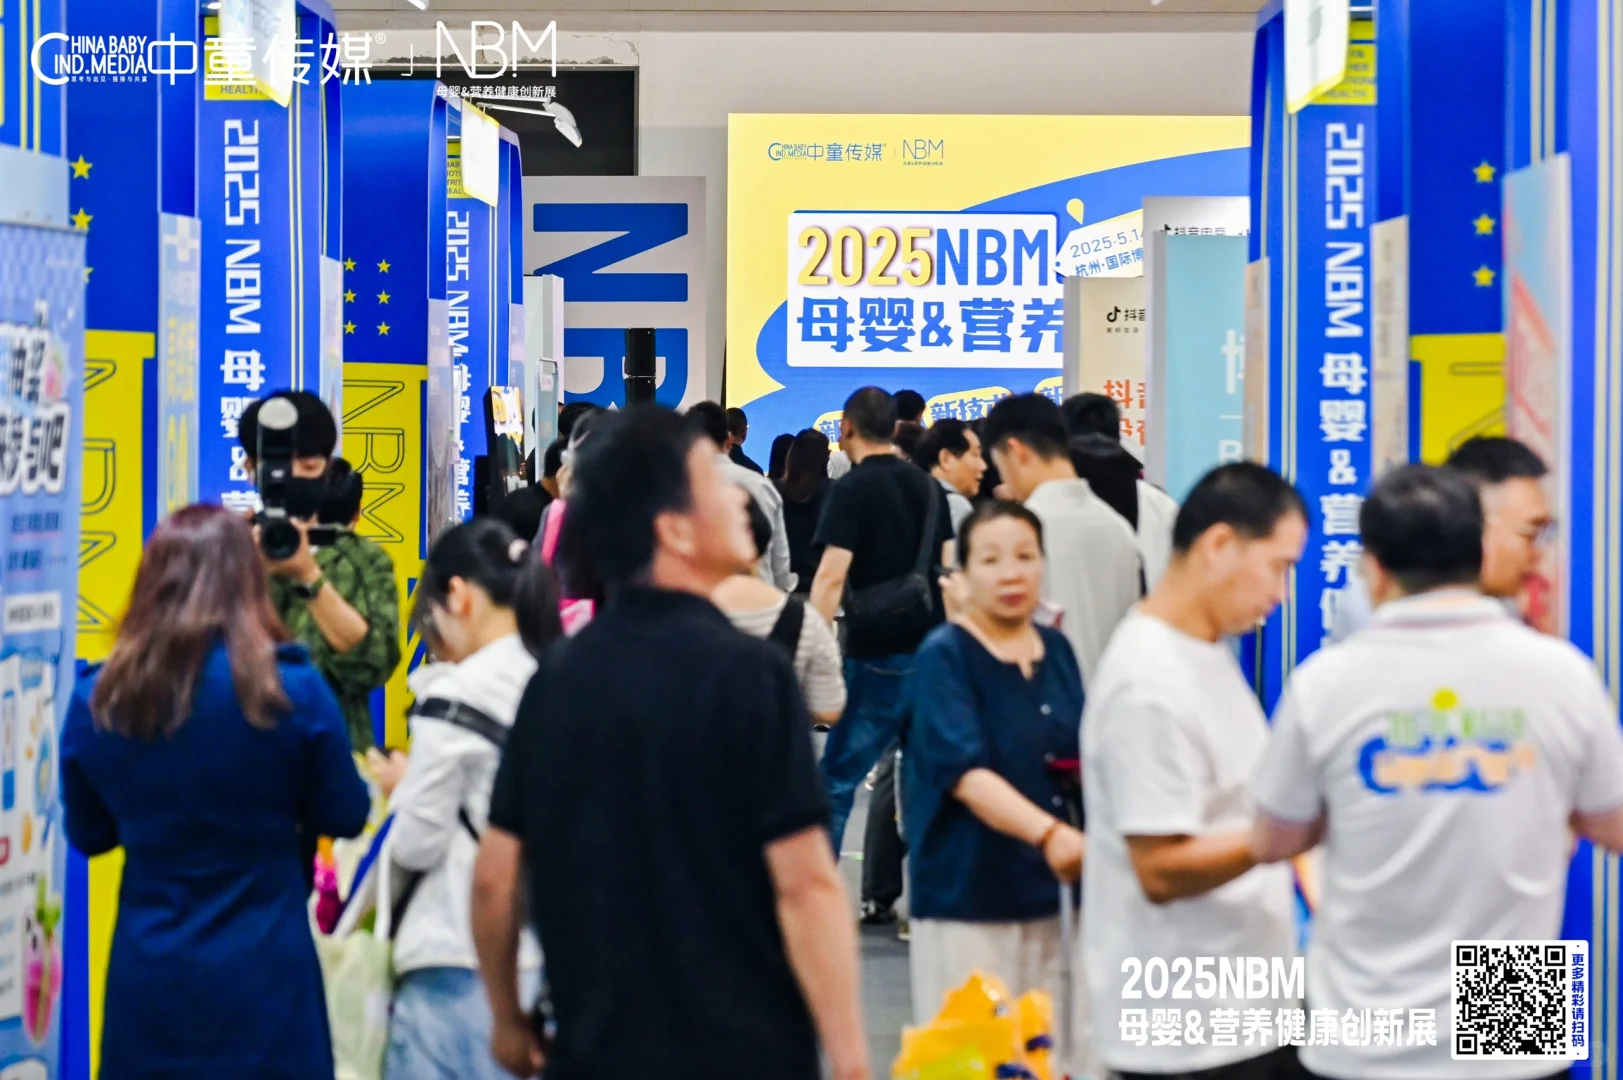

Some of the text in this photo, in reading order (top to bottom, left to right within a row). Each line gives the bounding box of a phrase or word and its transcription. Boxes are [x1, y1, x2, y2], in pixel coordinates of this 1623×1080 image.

[224, 119, 260, 226] 2025
[806, 143, 883, 161] 中童传媒
[903, 139, 944, 159] NBM
[1325, 123, 1364, 230] 2025
[225, 239, 261, 334] NBM
[798, 226, 1049, 287] 2025NBM
[1325, 242, 1364, 338] NBM
[797, 296, 1064, 353] 母婴&营养
